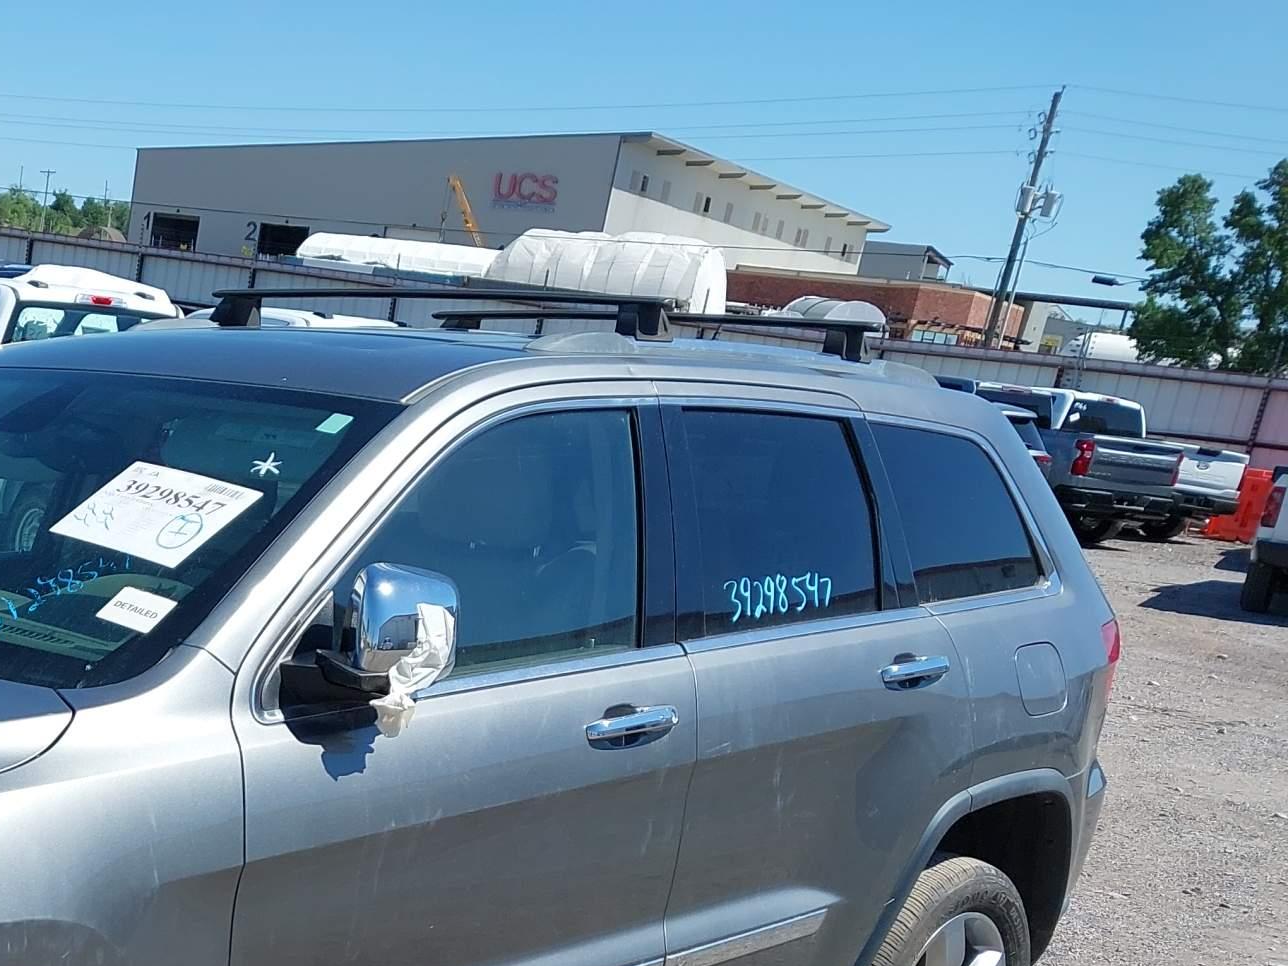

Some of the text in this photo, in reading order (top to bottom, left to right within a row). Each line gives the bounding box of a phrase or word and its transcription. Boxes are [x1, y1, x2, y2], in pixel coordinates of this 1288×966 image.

[494, 172, 559, 203] UCS
[143, 211, 152, 231] 1
[244, 221, 258, 242] 2
[116, 479, 228, 515] 39298547
[113, 599, 159, 620] DETAILED
[723, 571, 832, 623] 39298547
